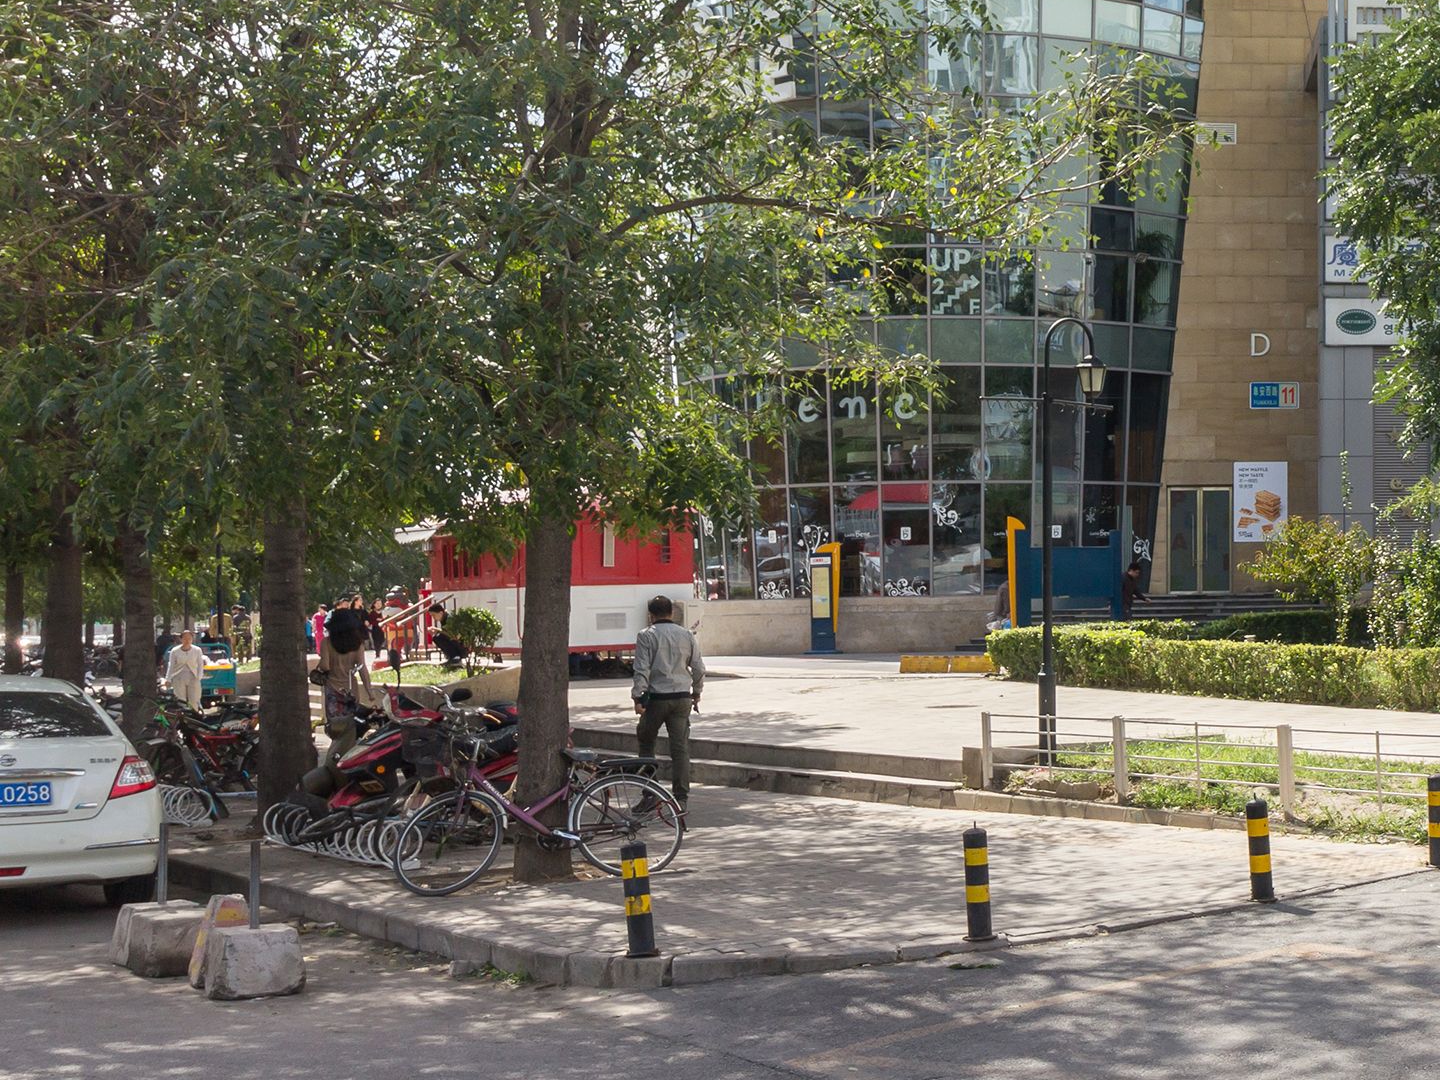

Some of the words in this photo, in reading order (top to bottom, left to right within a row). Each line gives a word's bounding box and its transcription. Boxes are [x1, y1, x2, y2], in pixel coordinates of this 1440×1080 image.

[930, 248, 972, 272] UP
[1250, 332, 1271, 356] D
[1282, 387, 1295, 404] 11
